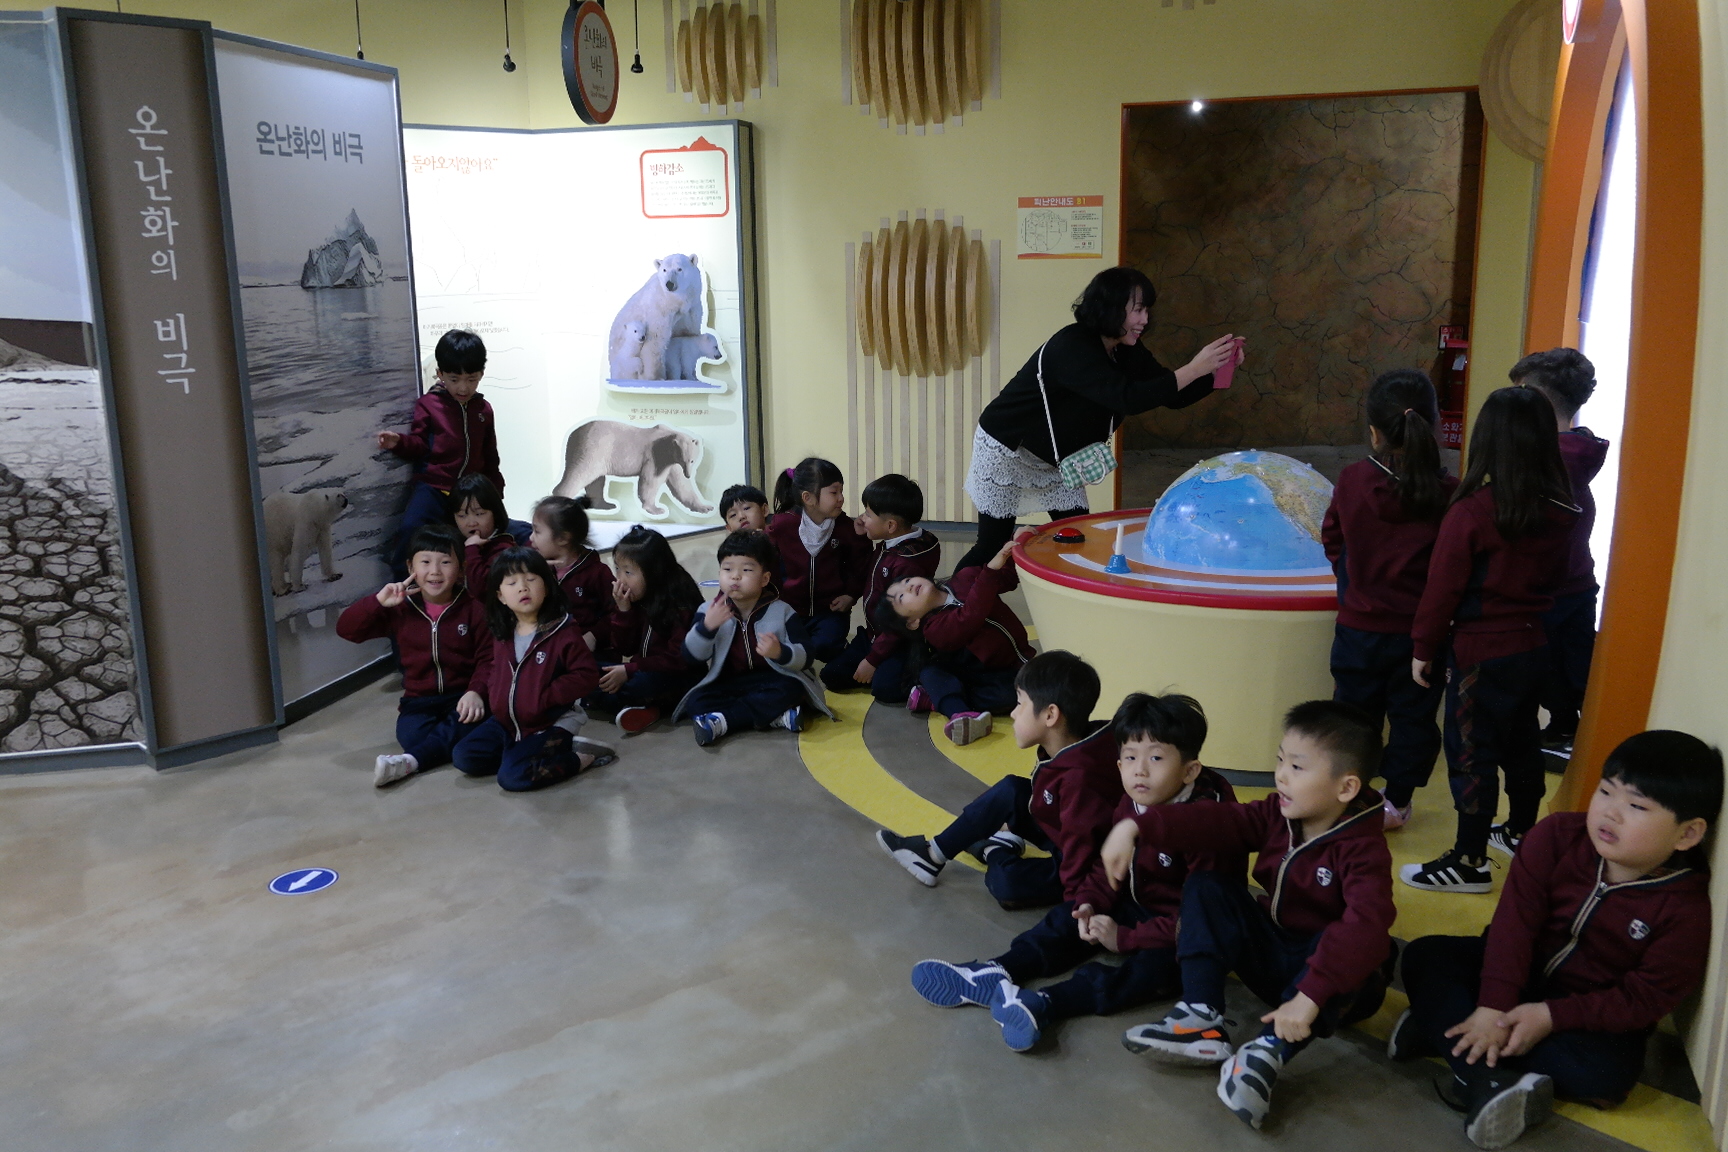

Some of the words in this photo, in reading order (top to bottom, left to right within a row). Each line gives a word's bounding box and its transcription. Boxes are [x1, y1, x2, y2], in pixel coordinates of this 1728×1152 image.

[255, 120, 327, 161] 온난화의
[332, 131, 363, 164] 비극
[649, 162, 685, 176] 빙하감소
[128, 105, 179, 280] 온난화의
[1034, 197, 1074, 206] 피난안내도
[153, 312, 196, 394] 비극
